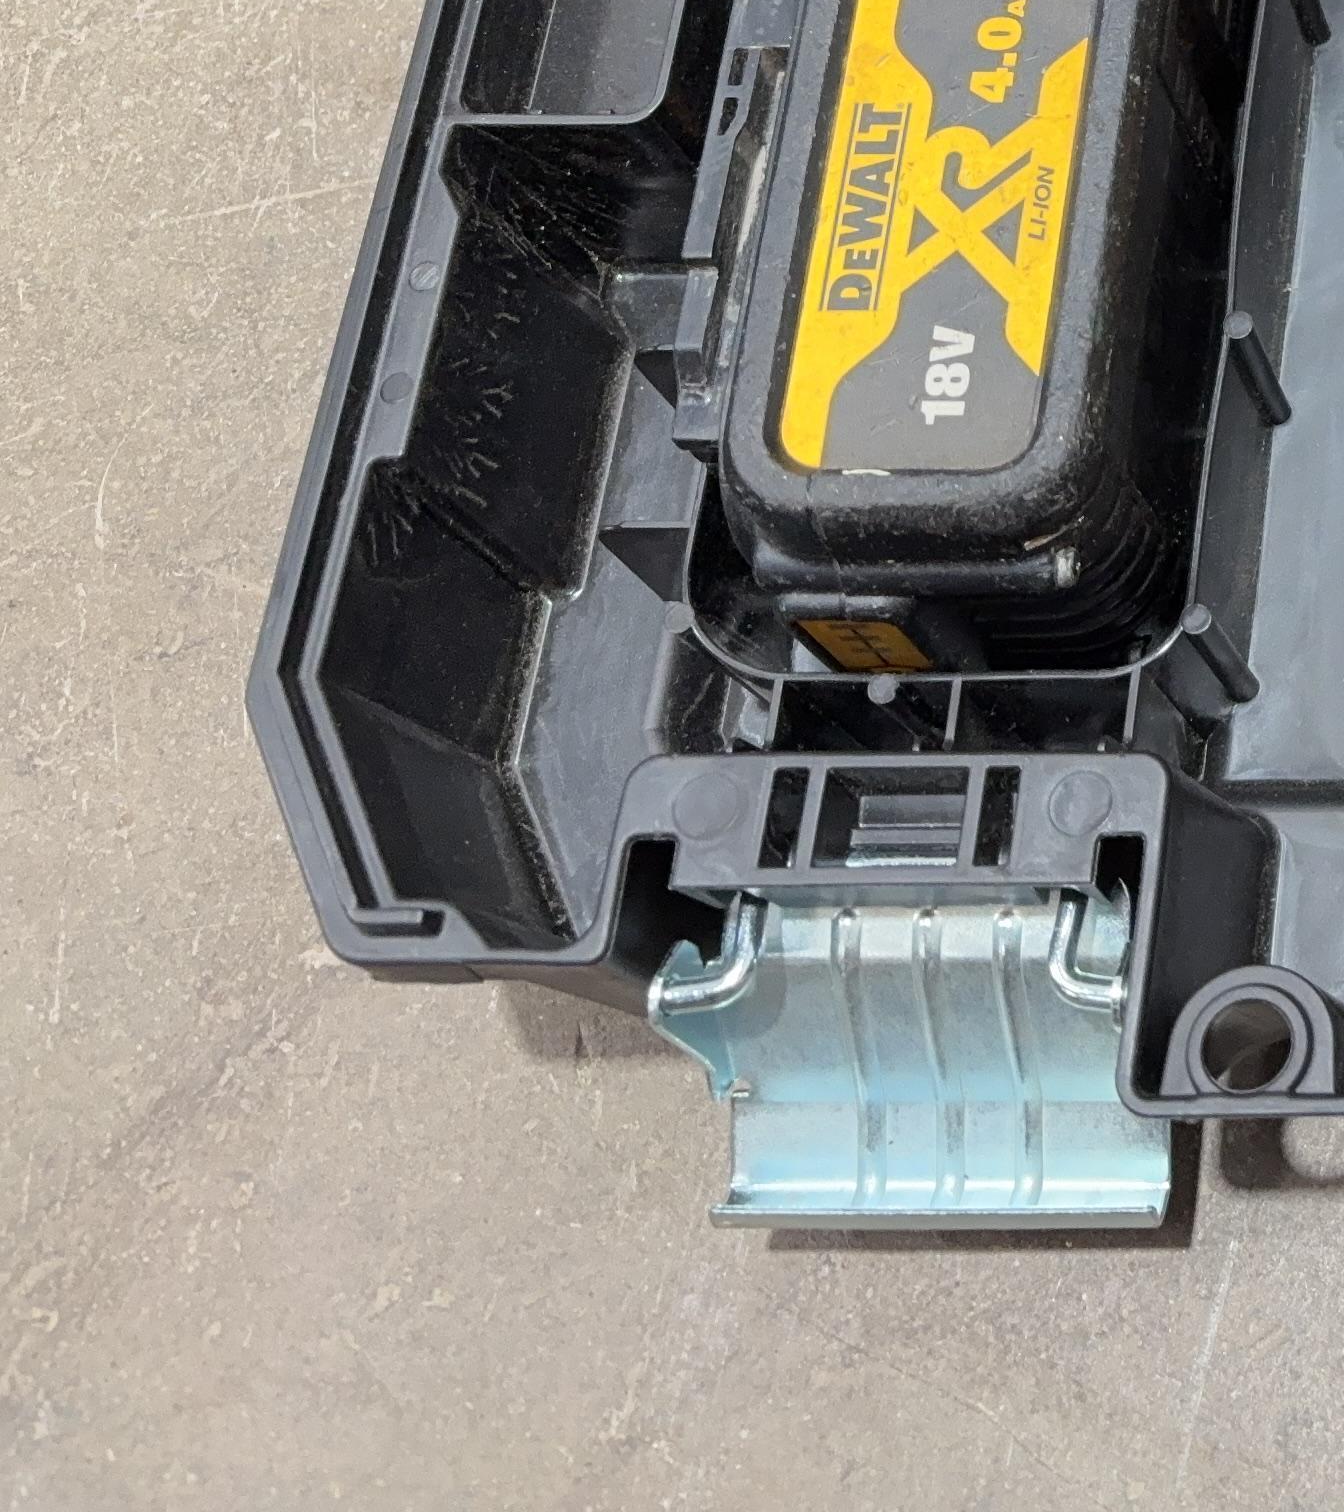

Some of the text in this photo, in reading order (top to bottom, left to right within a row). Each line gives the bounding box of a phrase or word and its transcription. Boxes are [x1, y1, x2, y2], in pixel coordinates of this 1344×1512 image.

[827, 104, 906, 312] DEWALT
[1028, 165, 1056, 242] LI-ION
[921, 326, 978, 426] 18V
